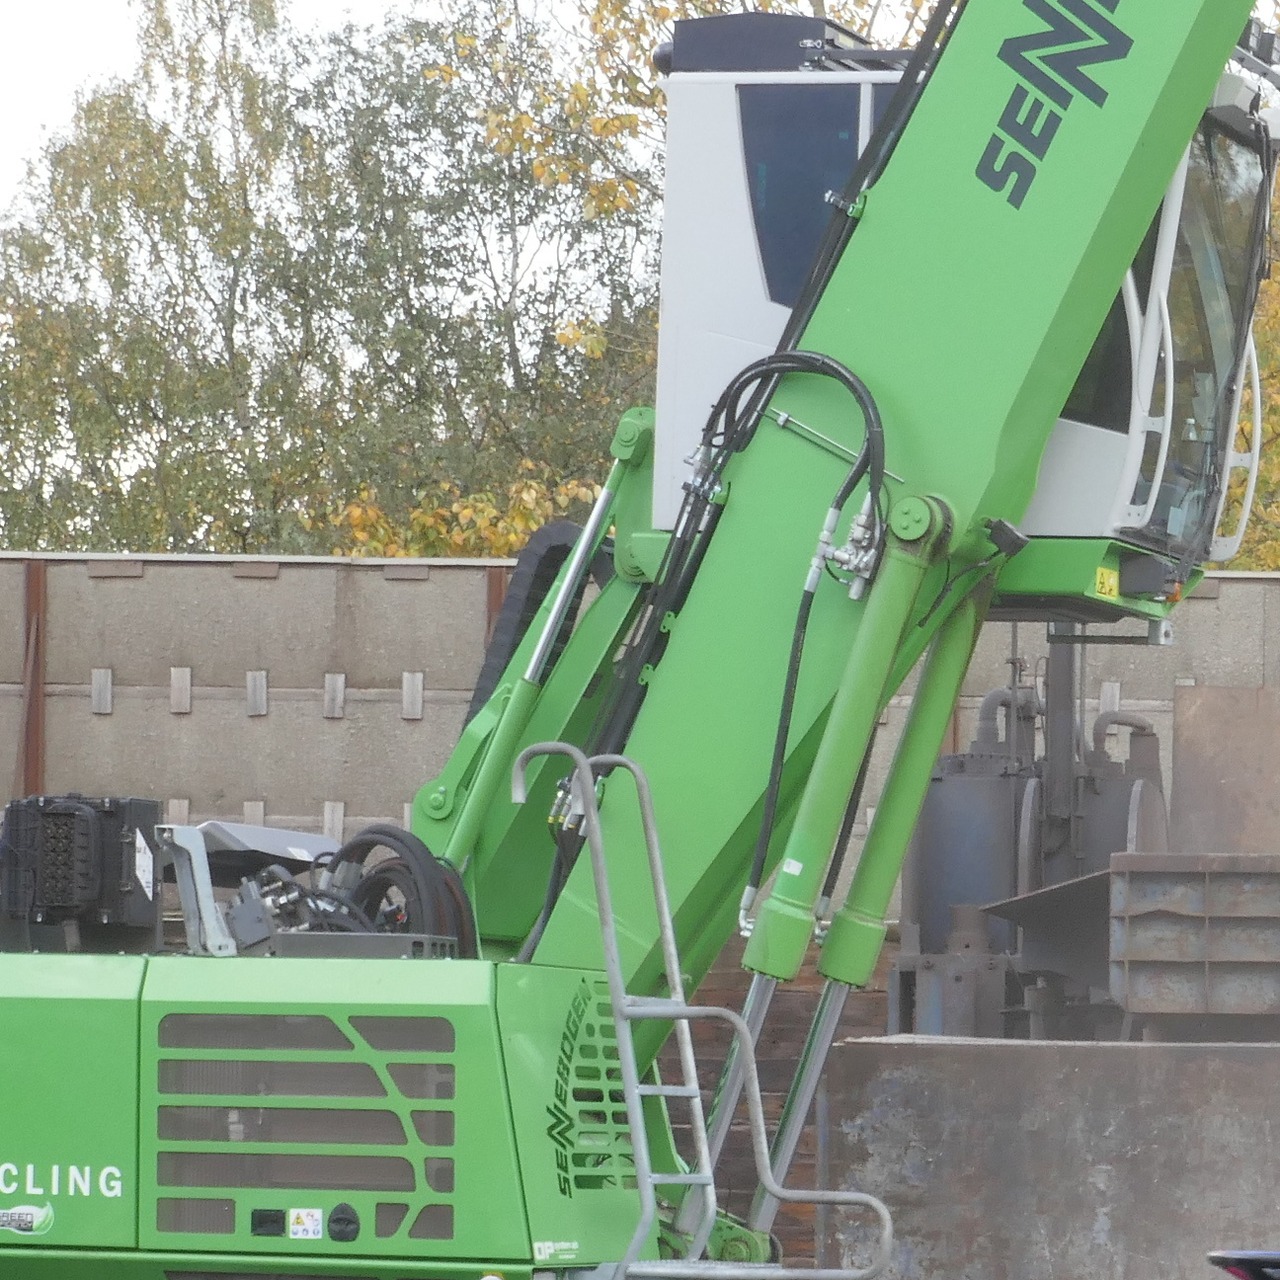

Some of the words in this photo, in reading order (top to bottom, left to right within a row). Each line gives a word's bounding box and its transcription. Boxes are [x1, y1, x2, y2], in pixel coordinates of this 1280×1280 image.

[975, 0, 1135, 211] SENN
[0, 1162, 122, 1197] CLING
[546, 976, 592, 1199] SENNEBOGEN
